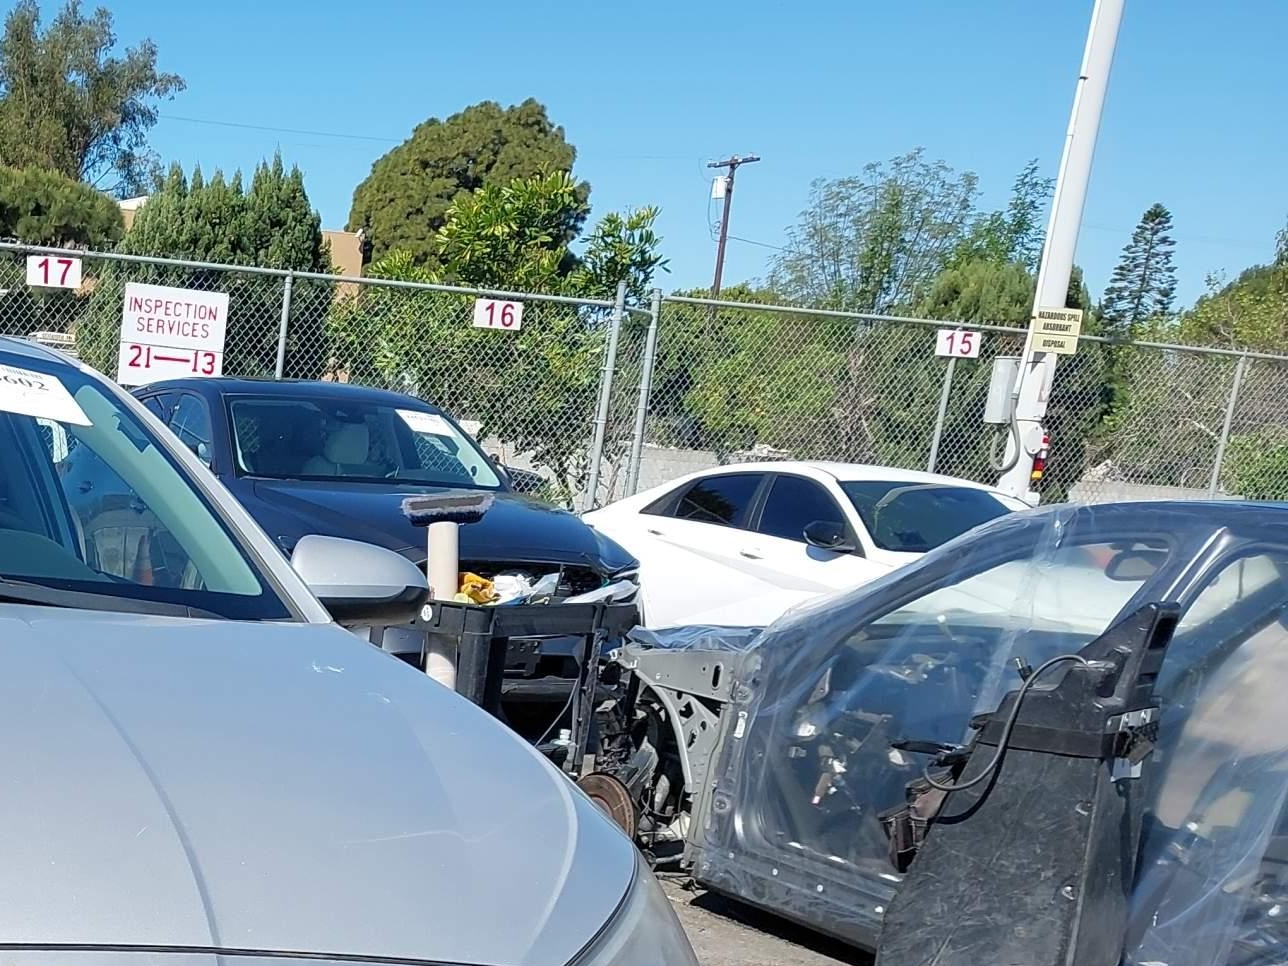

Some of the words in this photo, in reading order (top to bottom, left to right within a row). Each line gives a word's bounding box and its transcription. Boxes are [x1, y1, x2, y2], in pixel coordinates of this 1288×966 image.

[38, 258, 73, 285] 17
[129, 296, 218, 321] INSPECTION
[485, 302, 514, 327] 16
[137, 316, 210, 338] SERVICES
[946, 332, 973, 355] 15
